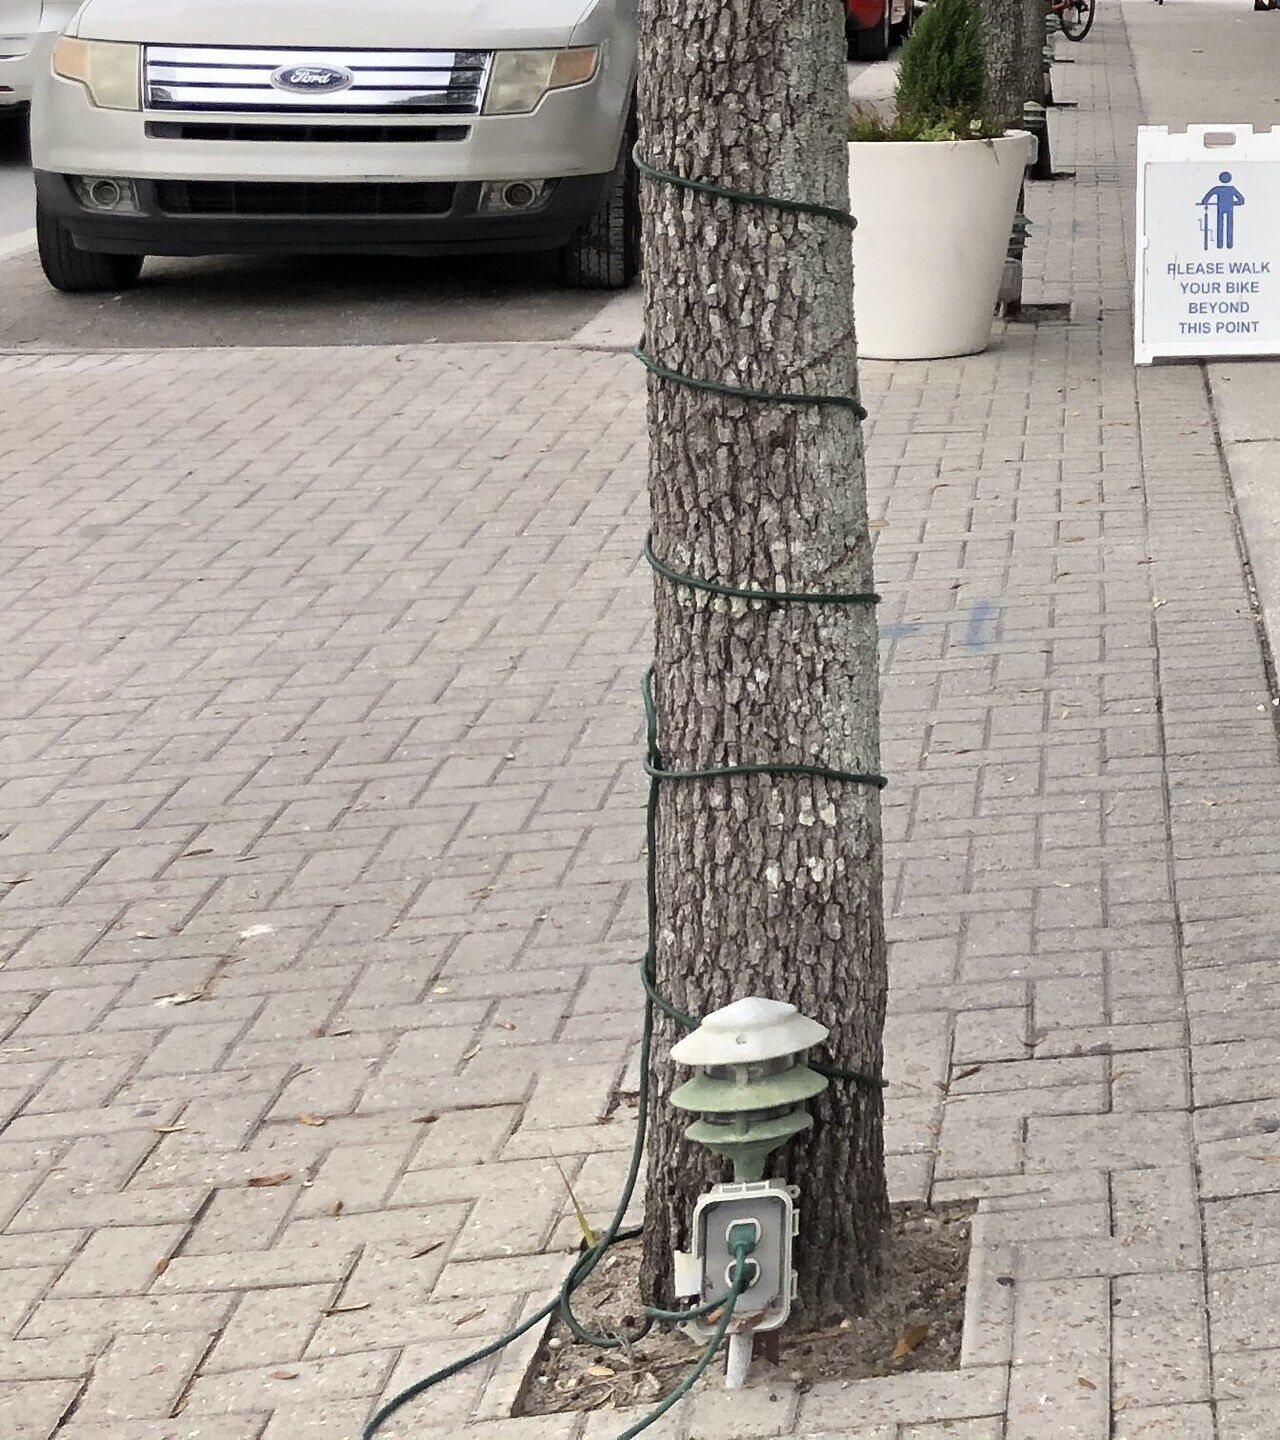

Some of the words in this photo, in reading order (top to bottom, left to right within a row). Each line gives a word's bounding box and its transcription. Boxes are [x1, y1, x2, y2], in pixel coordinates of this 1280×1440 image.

[290, 68, 332, 84] Ford
[1167, 262, 1225, 275] PLEASE
[1229, 262, 1271, 274] WALK
[1180, 282, 1221, 294] YOUR
[1226, 281, 1260, 294] BIKE
[1188, 301, 1250, 314] BEYOND
[1179, 322, 1212, 334] THIS
[1215, 321, 1260, 334] POINT
